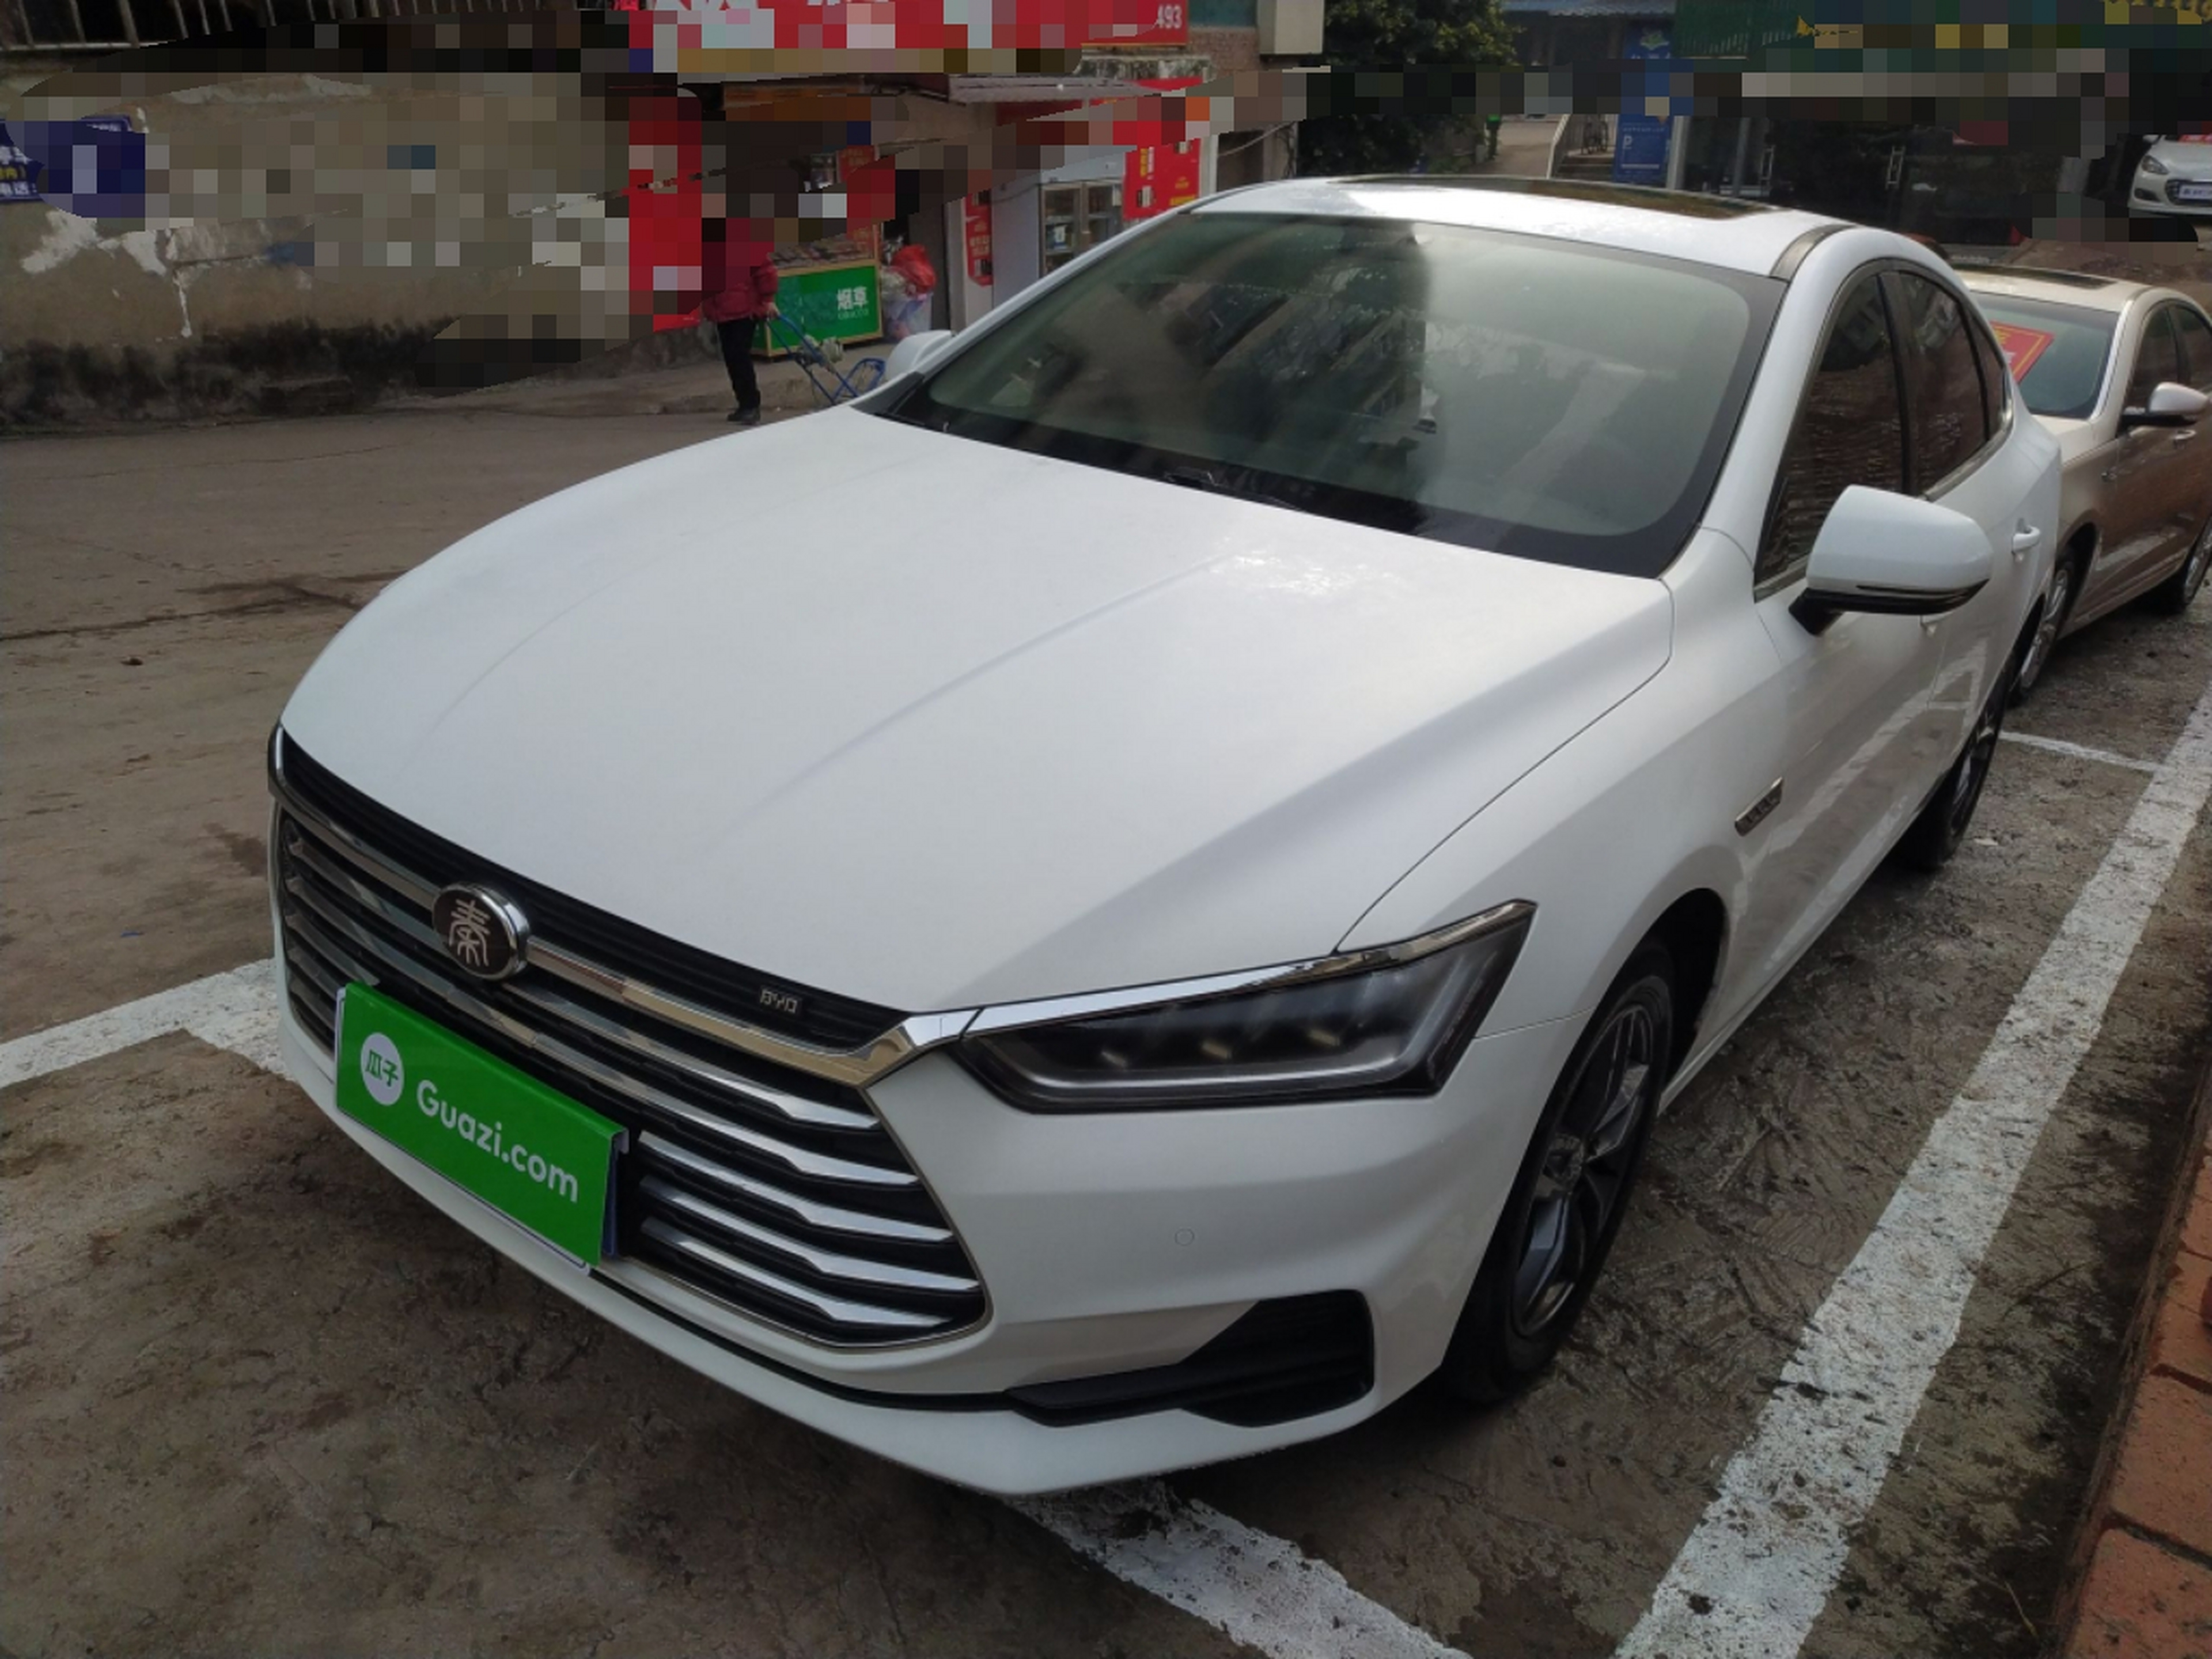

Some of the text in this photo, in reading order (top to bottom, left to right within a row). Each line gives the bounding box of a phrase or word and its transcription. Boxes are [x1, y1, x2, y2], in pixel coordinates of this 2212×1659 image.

[450, 899, 490, 967] 秦
[760, 990, 797, 1013] BYD
[366, 1050, 399, 1087] 瓜子
[417, 1080, 578, 1203] Guazi.com
